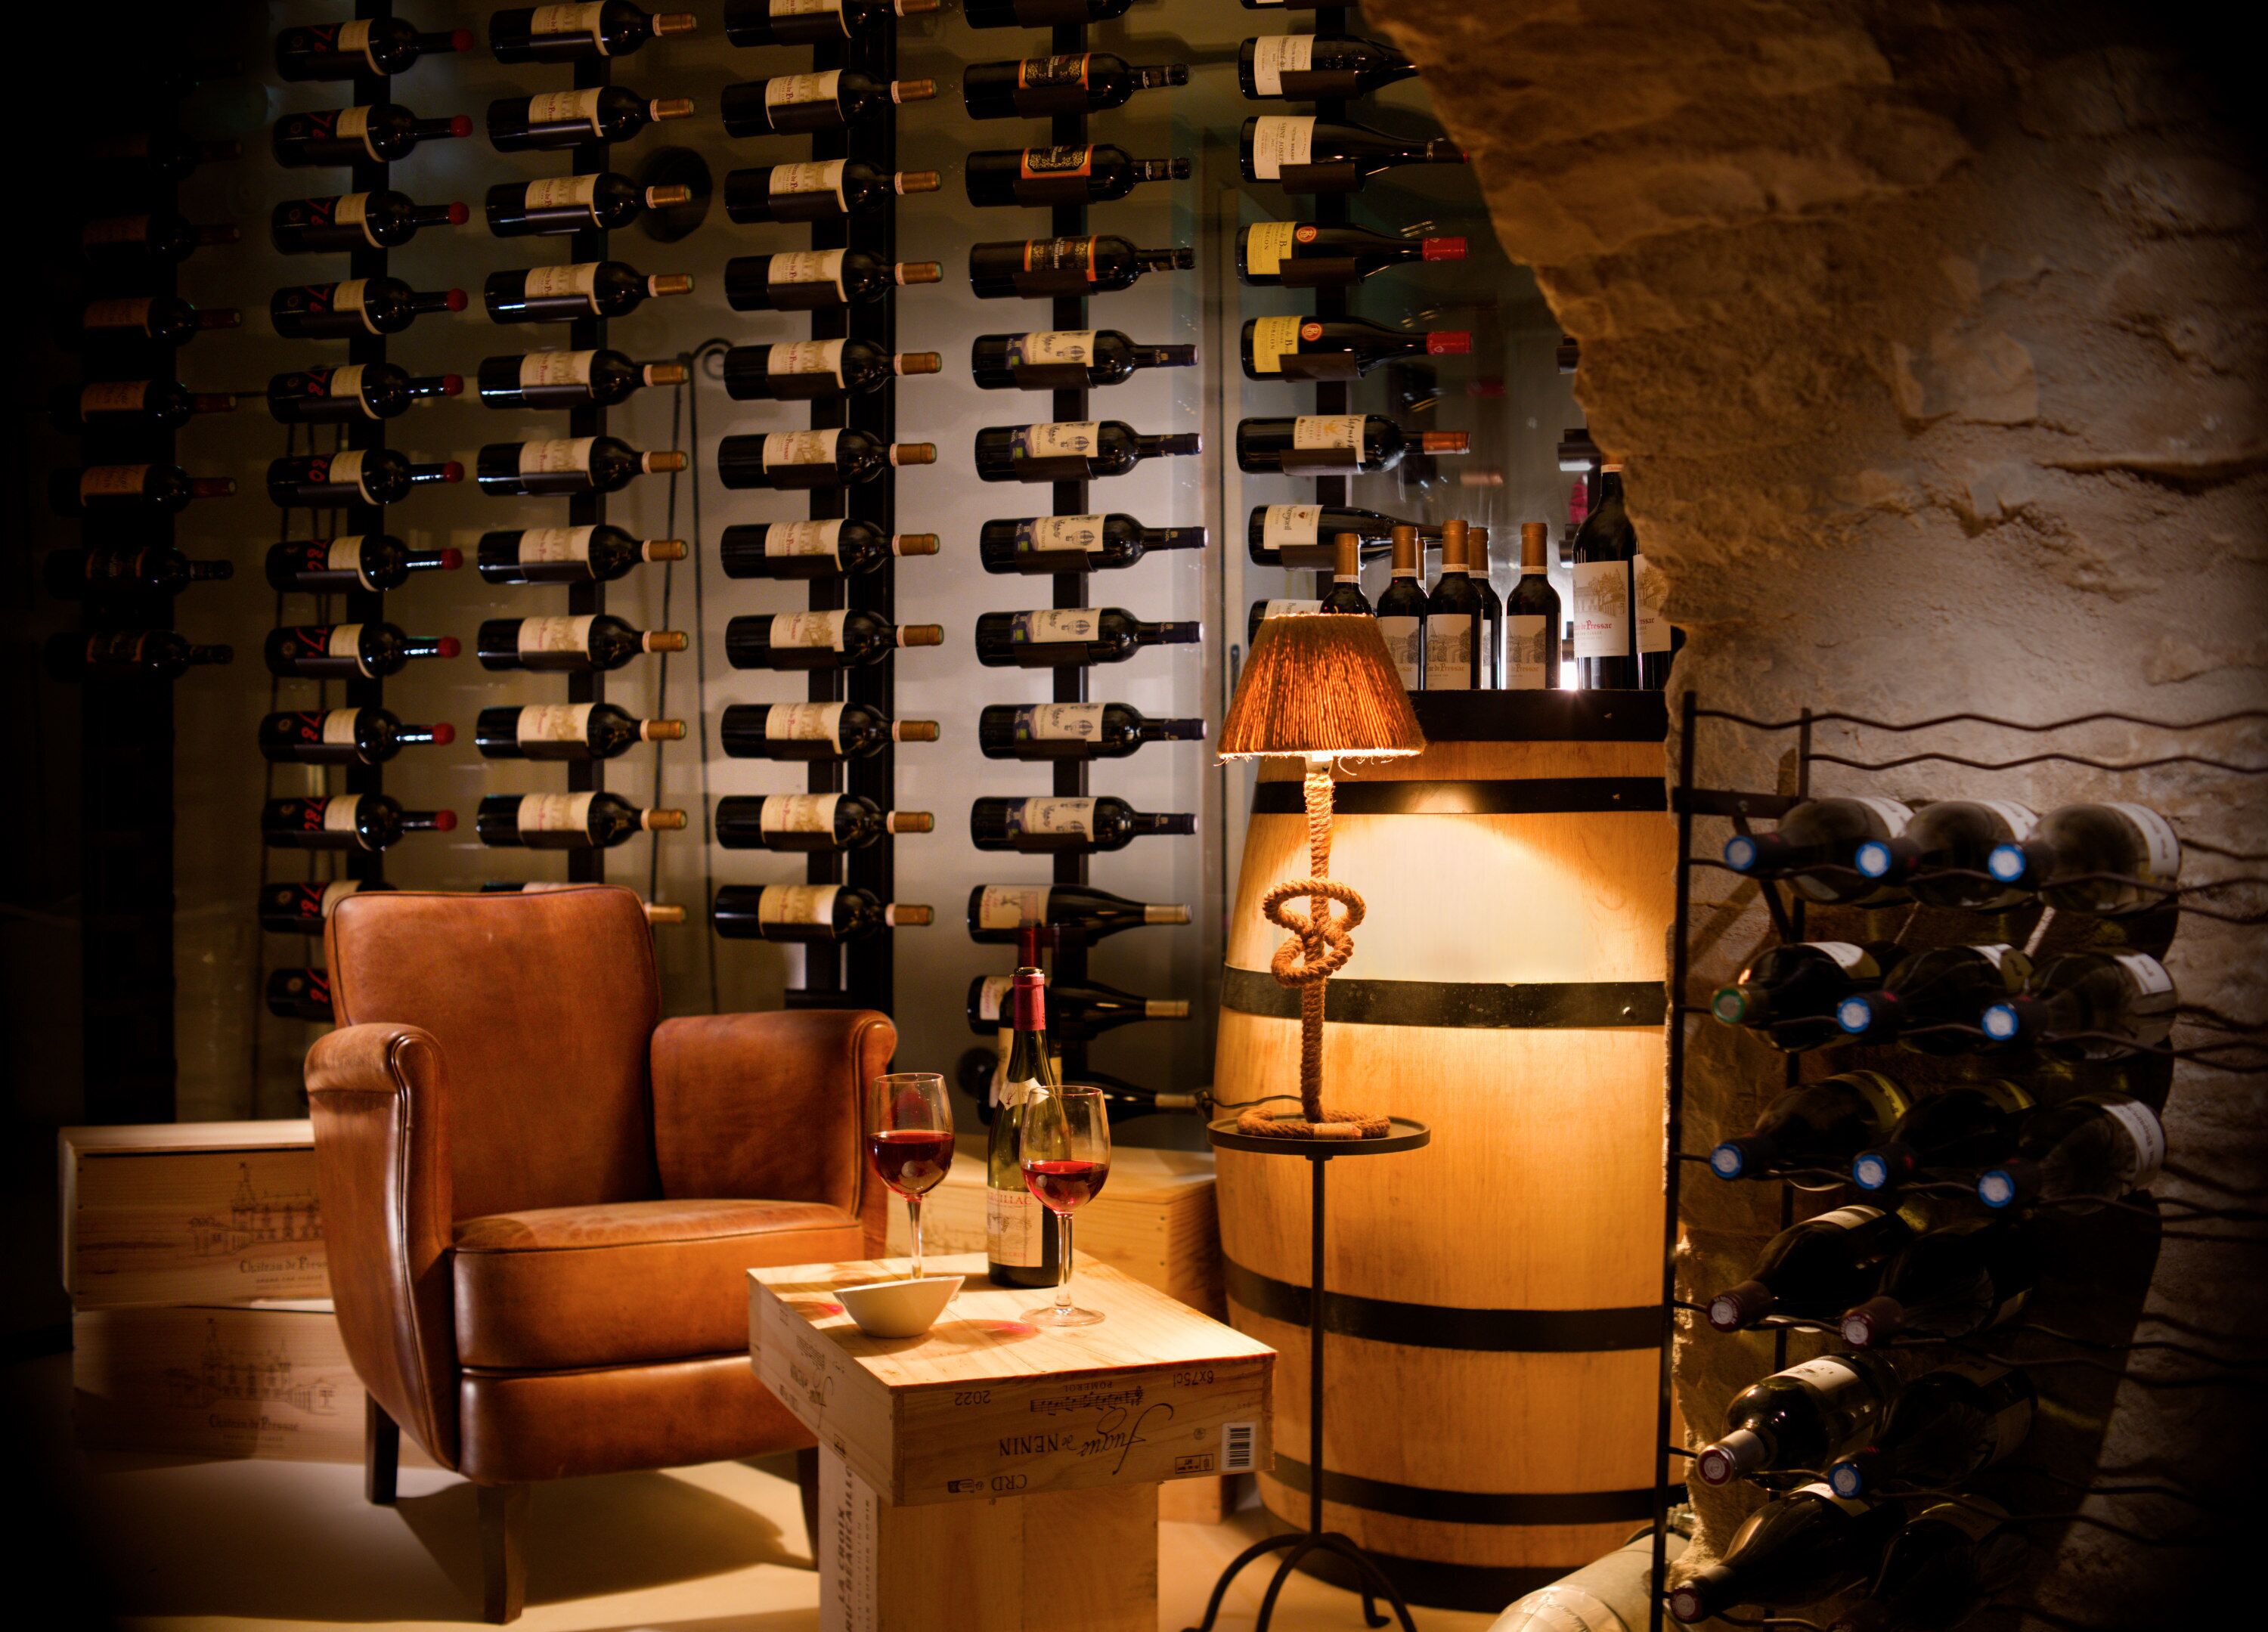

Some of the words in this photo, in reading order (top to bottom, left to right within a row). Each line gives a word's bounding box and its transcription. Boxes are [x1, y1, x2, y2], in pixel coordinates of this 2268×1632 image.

[1586, 619, 1613, 630] Pressac
[1440, 662, 1464, 672] Pressac
[1063, 1380, 1113, 1392] POMEROL
[1173, 1370, 1214, 1389] 6x75cl
[953, 1390, 992, 1407] 2022
[998, 1433, 1059, 1457] NENIN
[991, 1474, 1028, 1491] CRD
[838, 1579, 845, 1604] LA
